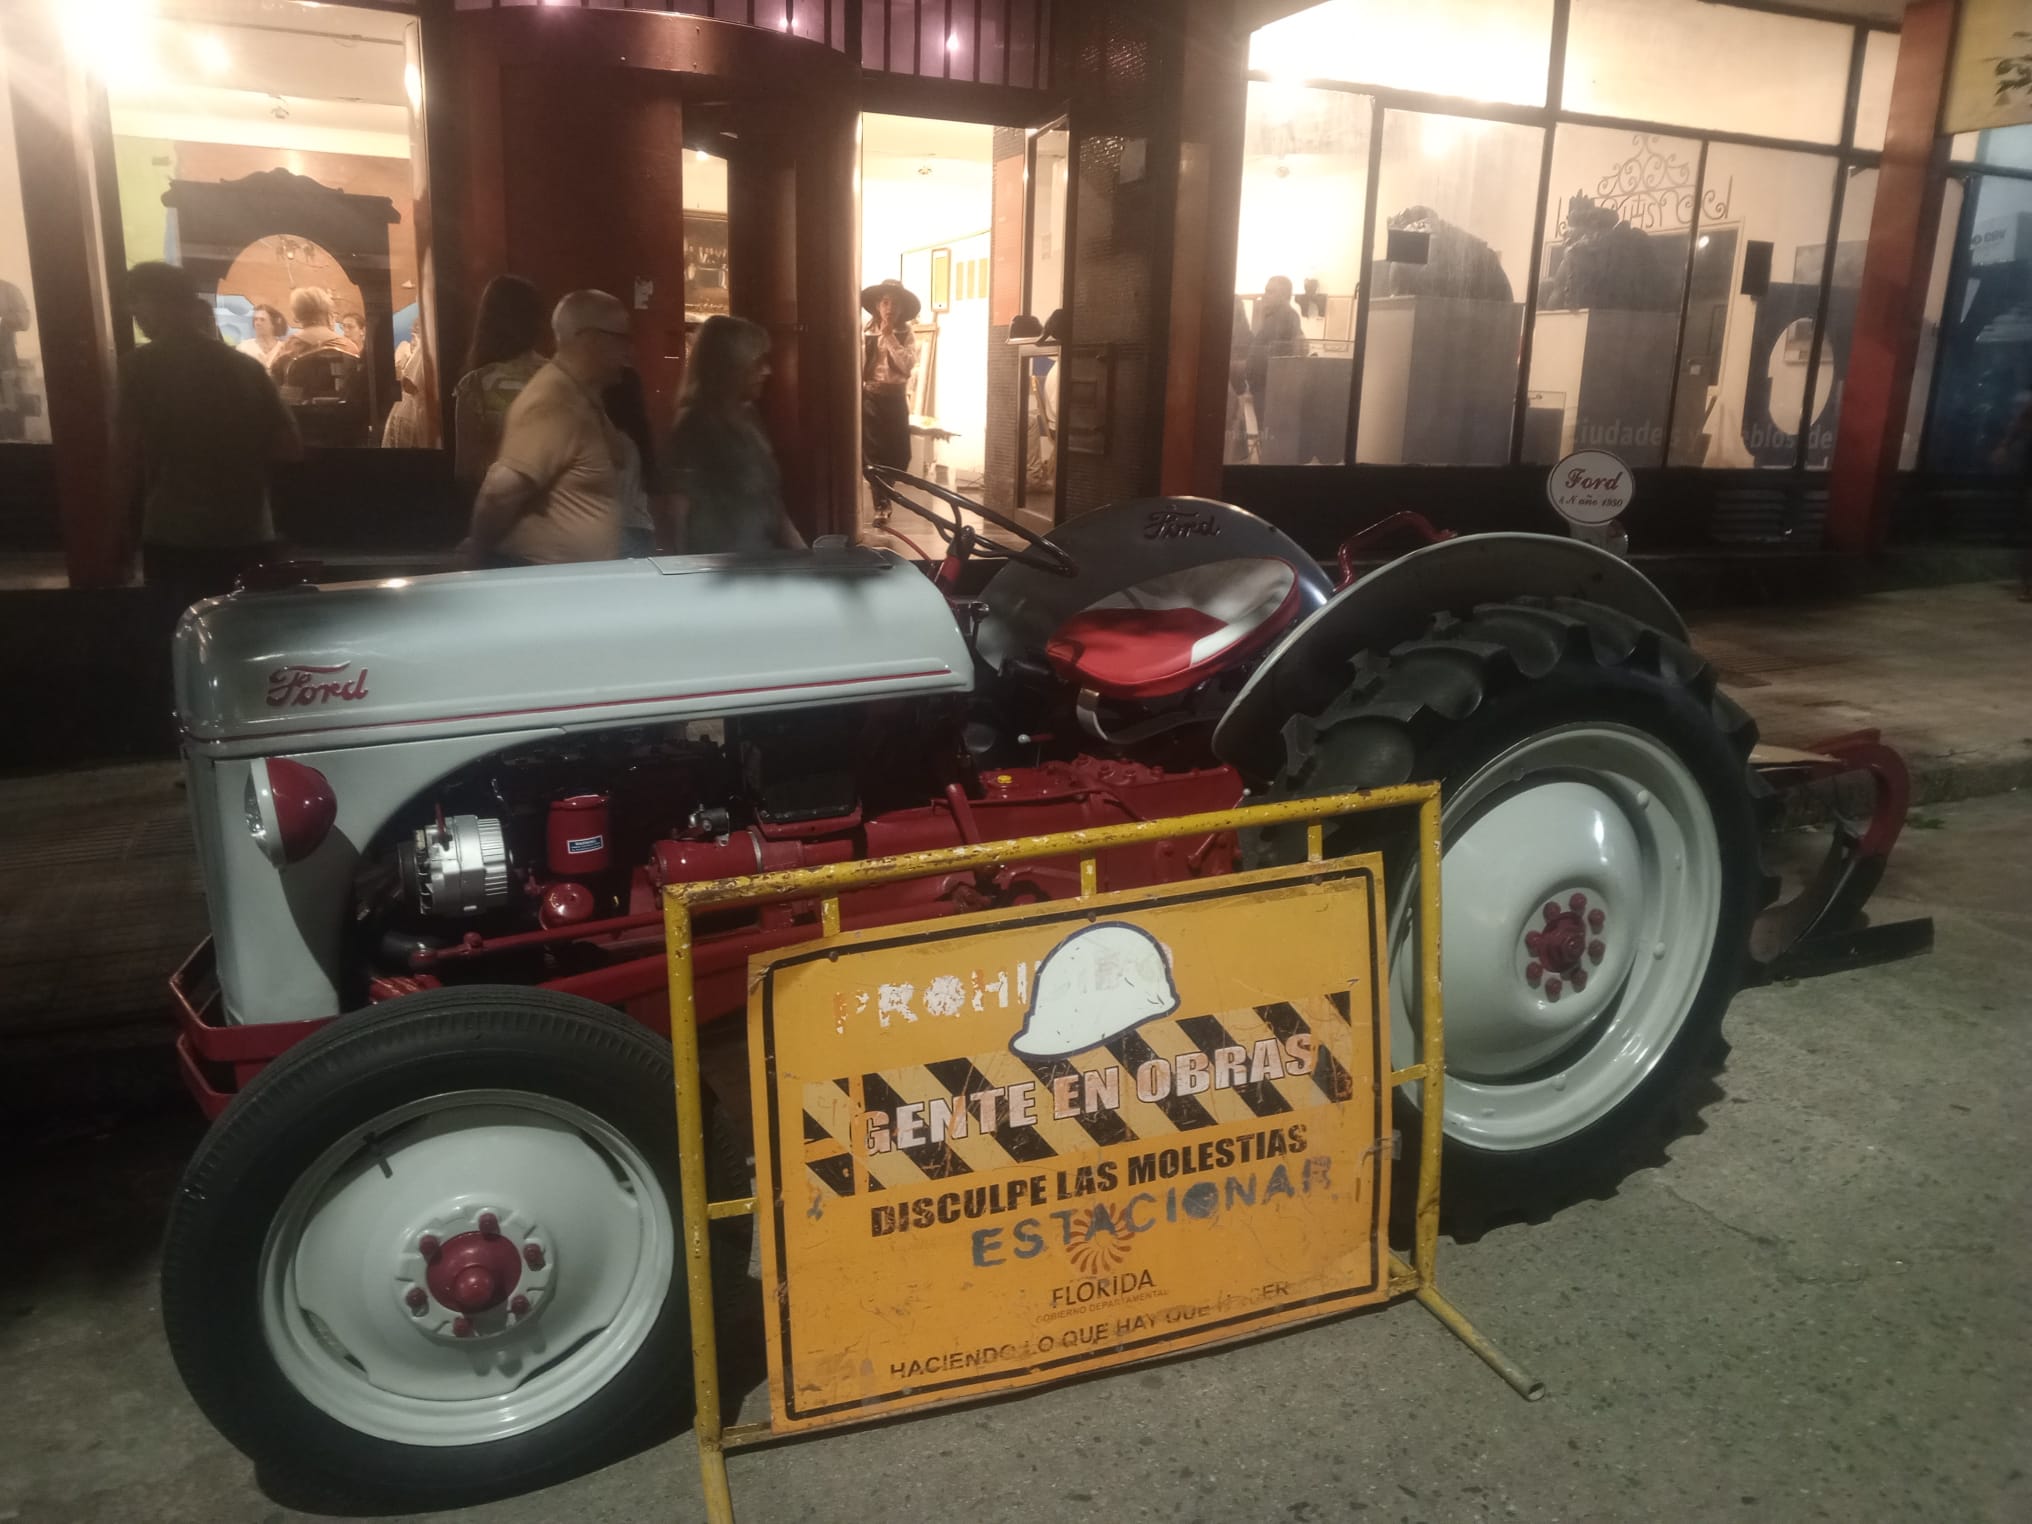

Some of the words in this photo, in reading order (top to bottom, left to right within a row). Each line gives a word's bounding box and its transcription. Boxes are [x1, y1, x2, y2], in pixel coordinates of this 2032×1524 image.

[1575, 418, 1681, 447] iudades
[1808, 423, 1833, 449] de
[1564, 467, 1624, 490] Ford
[1143, 512, 1222, 540] Ford
[265, 659, 369, 707] Ford
[863, 1081, 1036, 1156] GENTE
[1053, 1065, 1121, 1121] EN
[1136, 1033, 1313, 1103] OBRAS
[871, 1174, 1047, 1238] DISCULPE
[1056, 1161, 1119, 1201] LAS
[1127, 1123, 1308, 1187] MOLESTIAS
[971, 1156, 1332, 1268] ESTACIONAR
[890, 1343, 1017, 1379] HACIENDO
[1062, 1322, 1109, 1349] QUE
[1116, 1312, 1157, 1337] HAY
